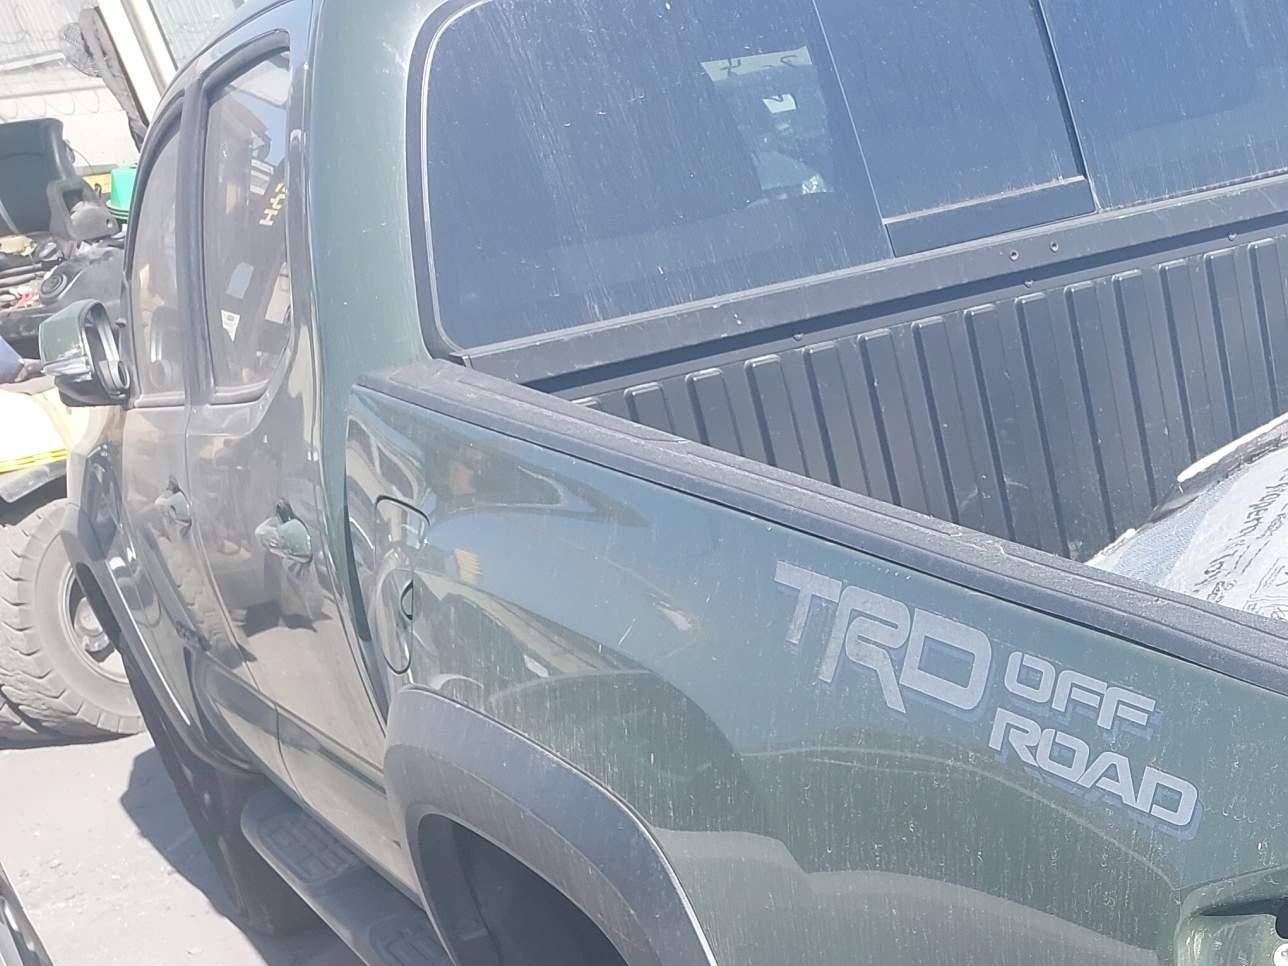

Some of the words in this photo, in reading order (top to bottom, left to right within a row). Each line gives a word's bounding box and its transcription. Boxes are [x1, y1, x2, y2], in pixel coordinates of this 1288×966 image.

[775, 560, 992, 713] TRD
[1004, 651, 1156, 729] OFF
[989, 707, 1198, 825] ROAD
